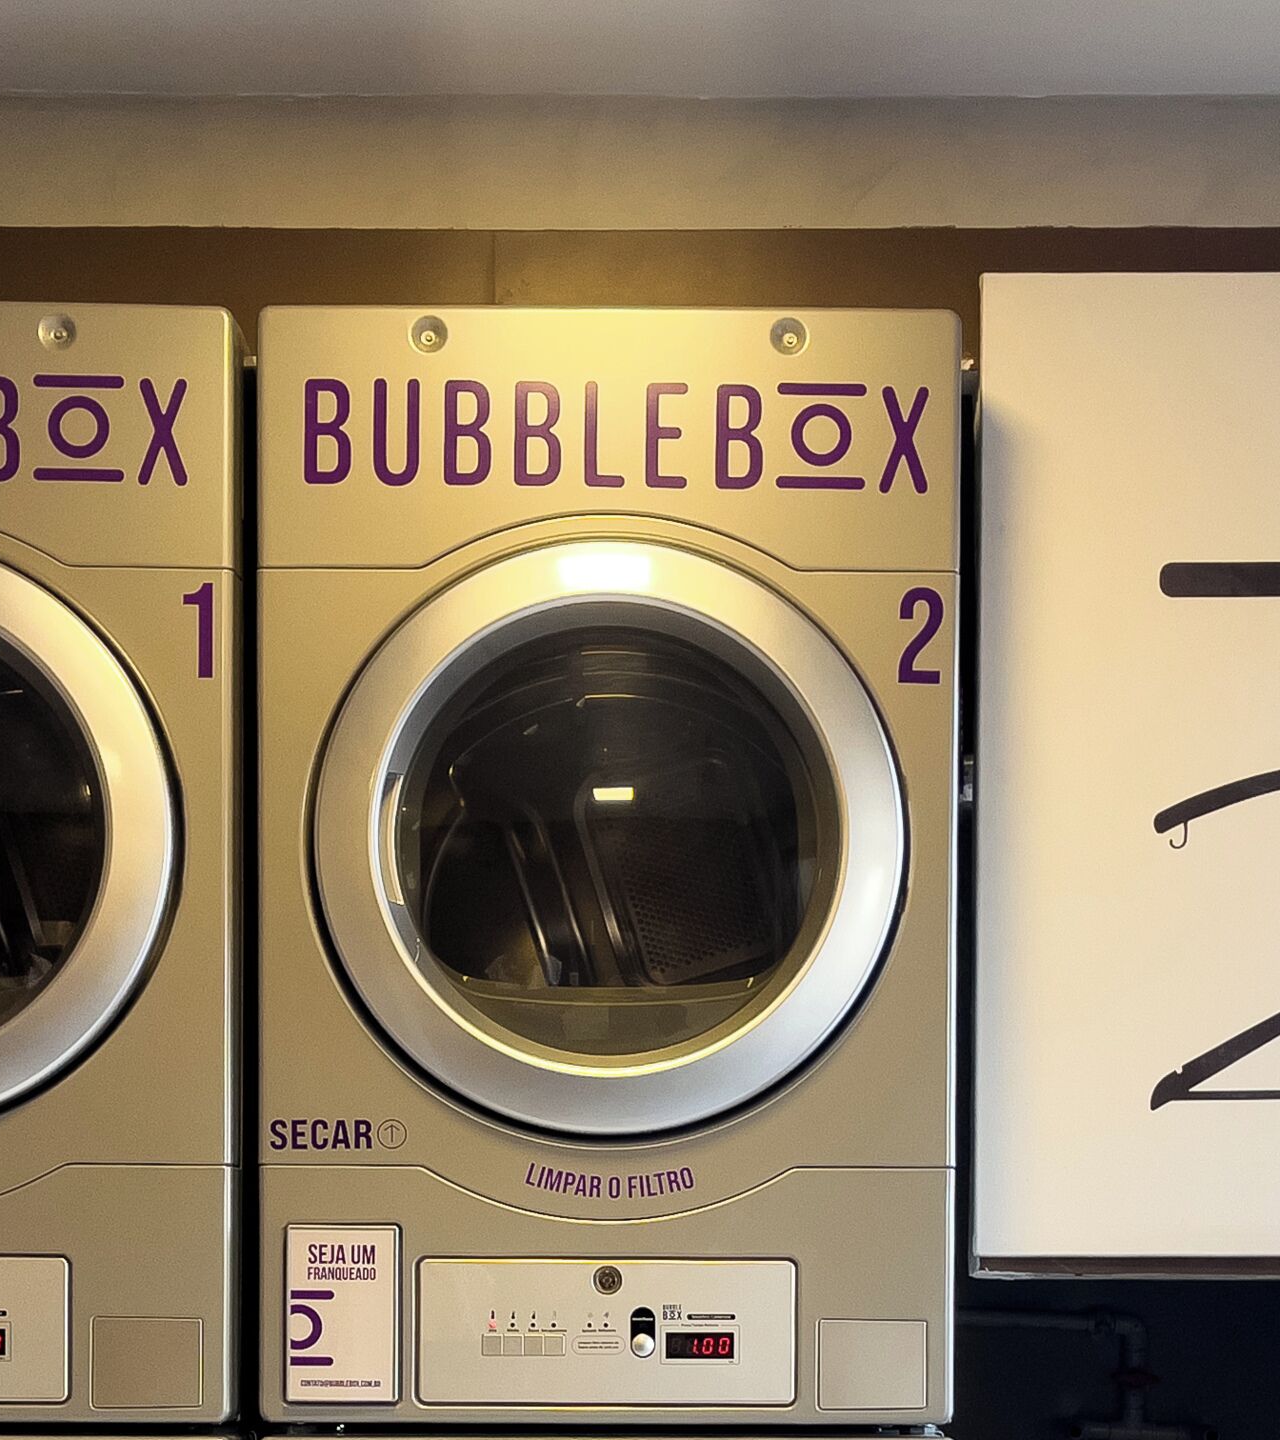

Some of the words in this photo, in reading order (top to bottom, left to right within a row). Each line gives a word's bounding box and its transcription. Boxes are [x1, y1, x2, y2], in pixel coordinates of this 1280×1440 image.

[303, 378, 930, 494] BUBBLEBOX
[182, 582, 214, 678] 1
[898, 587, 945, 684] 2
[270, 1119, 372, 1150] SECAR
[525, 1163, 602, 1198] LIMPAR
[608, 1176, 621, 1198] O
[628, 1167, 694, 1198] FILTRO
[308, 1244, 346, 1264] SEJA
[351, 1245, 375, 1265] UM
[308, 1267, 376, 1280] FRANQUEADO
